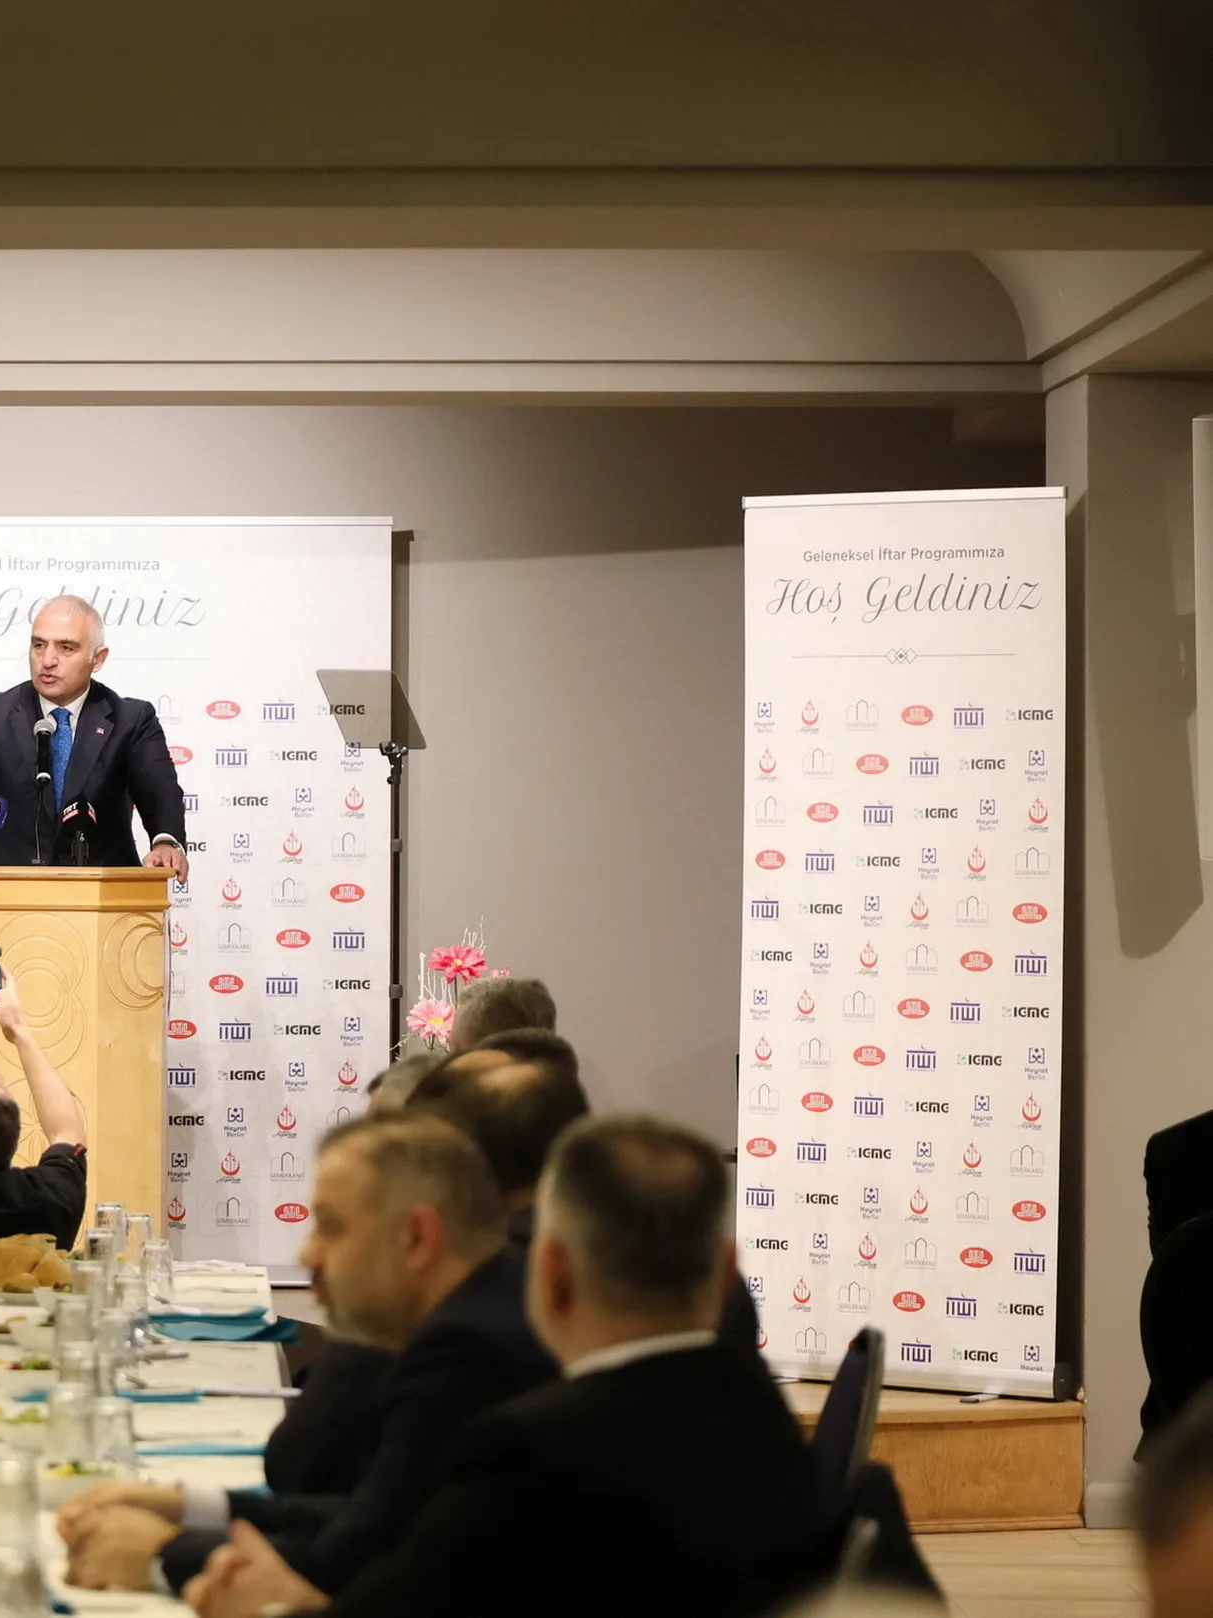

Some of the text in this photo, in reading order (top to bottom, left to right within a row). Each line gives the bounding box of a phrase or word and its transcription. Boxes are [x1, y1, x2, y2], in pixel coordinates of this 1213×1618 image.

[803, 546, 1004, 562] Geleneksel İftar Programımıza
[8, 556, 41, 571] İftar
[47, 559, 159, 574] Programımıza
[766, 573, 1043, 624] Hoş Geldiniz
